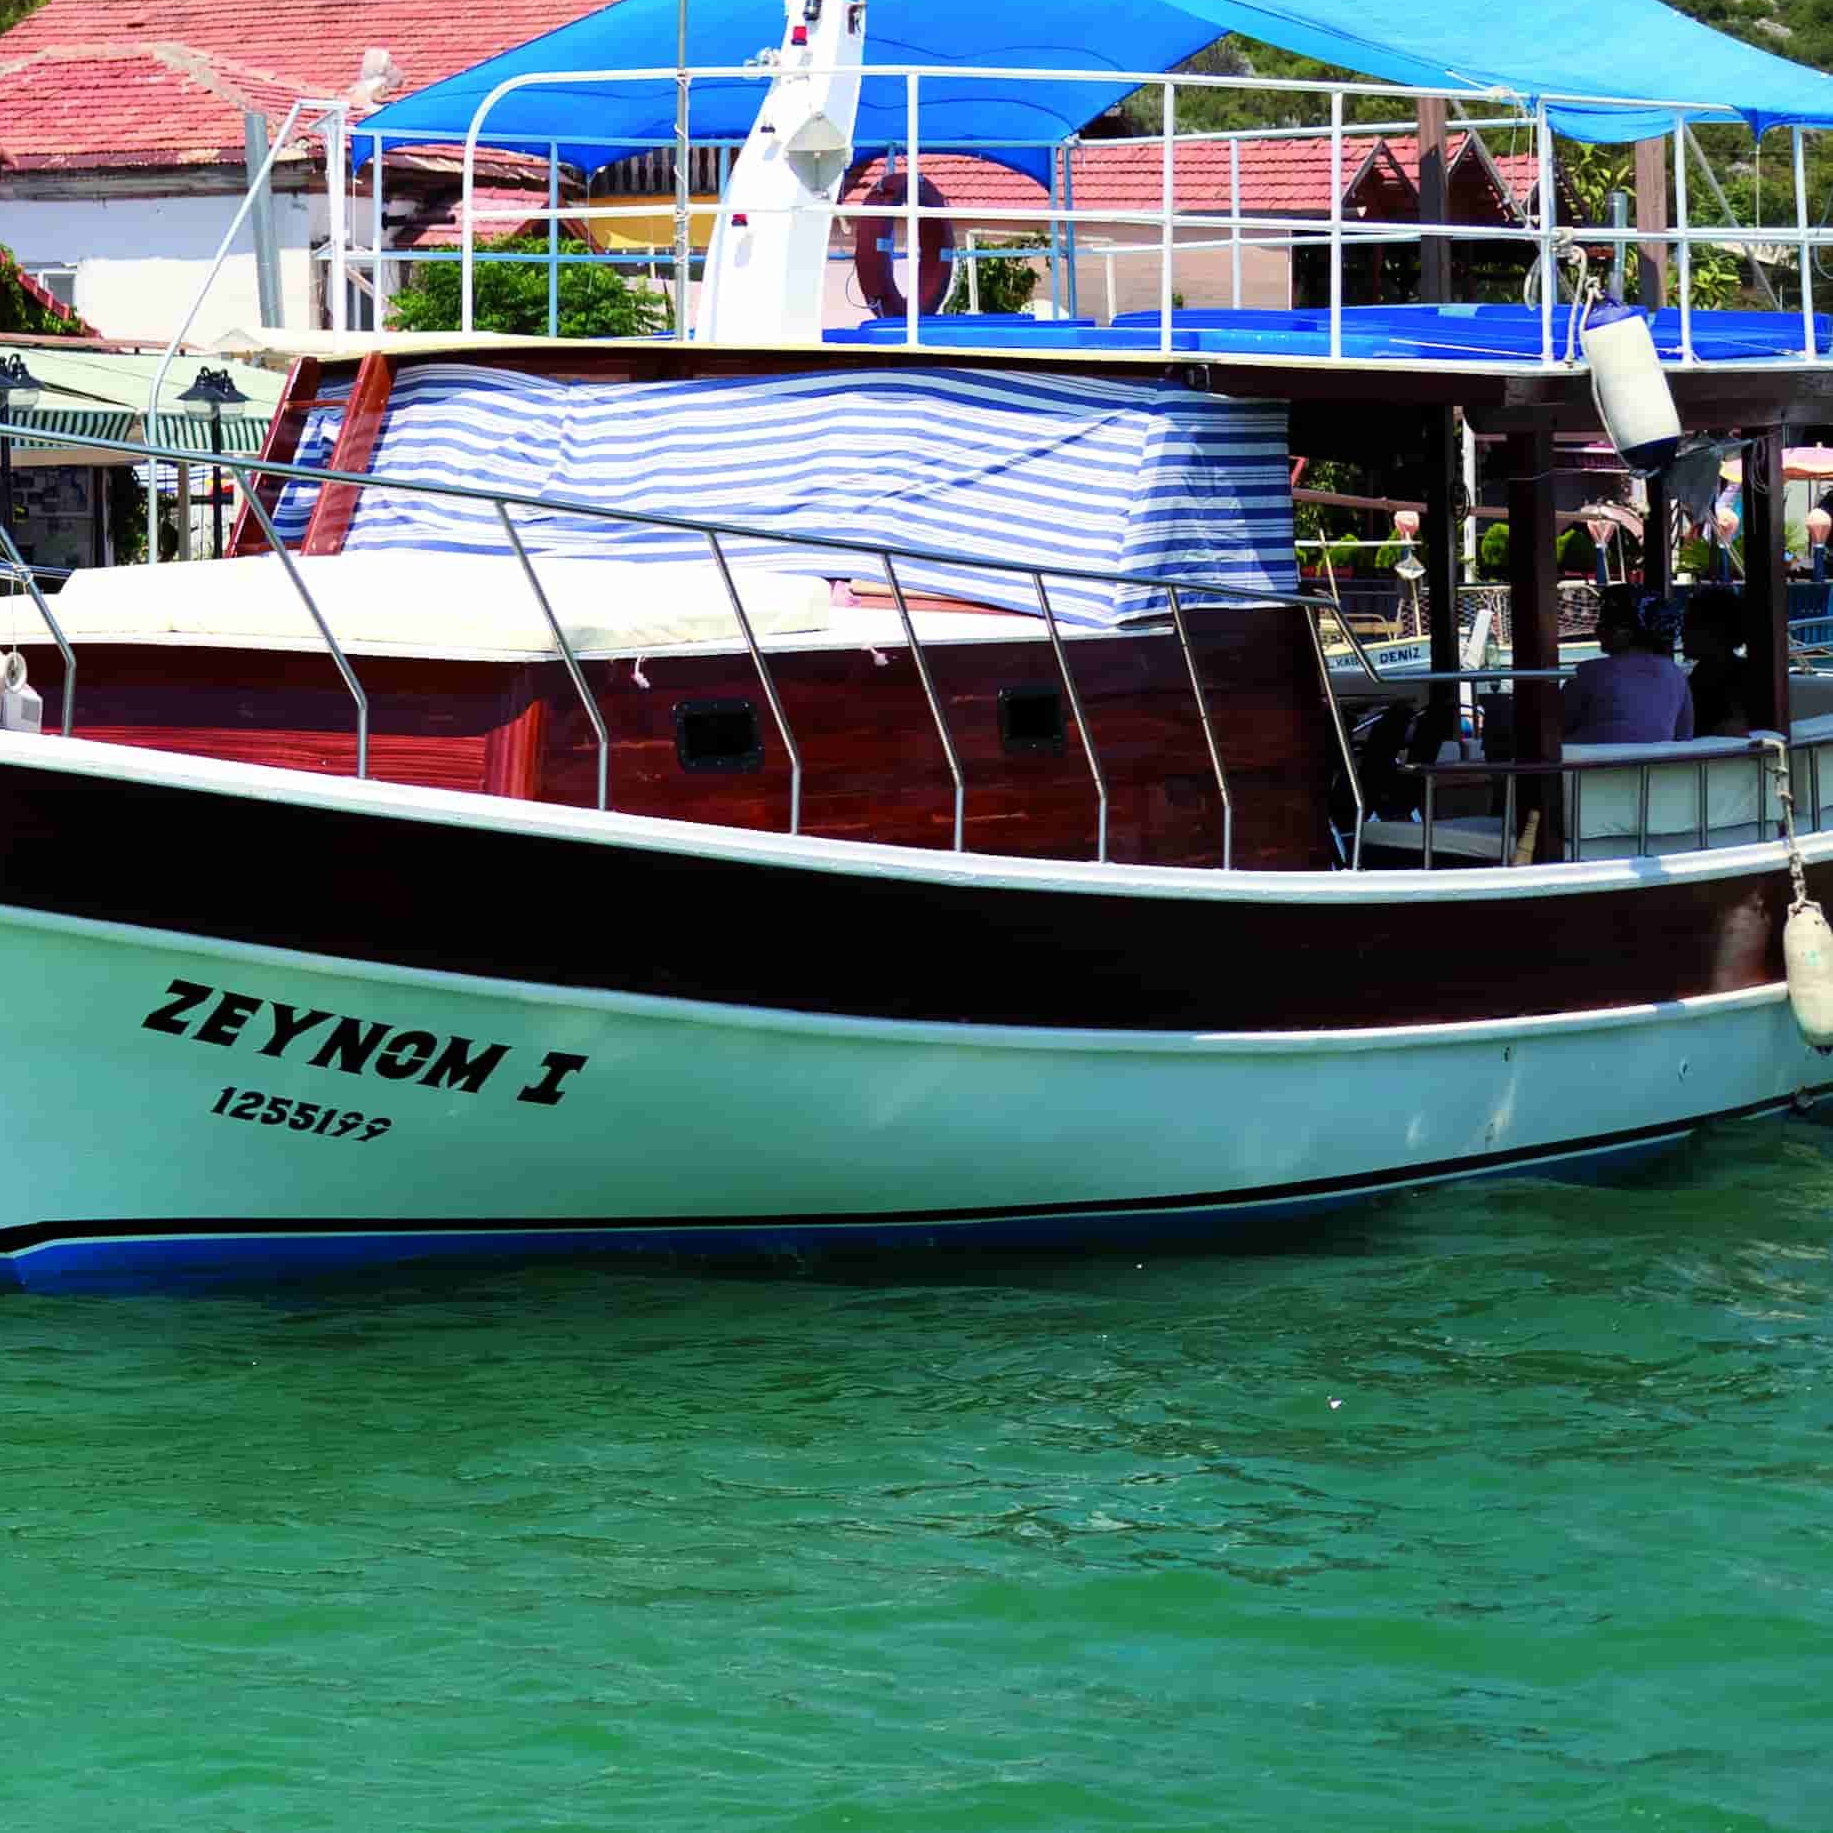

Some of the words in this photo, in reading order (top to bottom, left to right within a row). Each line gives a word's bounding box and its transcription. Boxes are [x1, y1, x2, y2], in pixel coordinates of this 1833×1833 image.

[1379, 647, 1421, 664] DENİZ
[141, 979, 513, 1094] ZEYNOM
[517, 1051, 589, 1106] I
[210, 1086, 393, 1142] 1255199
